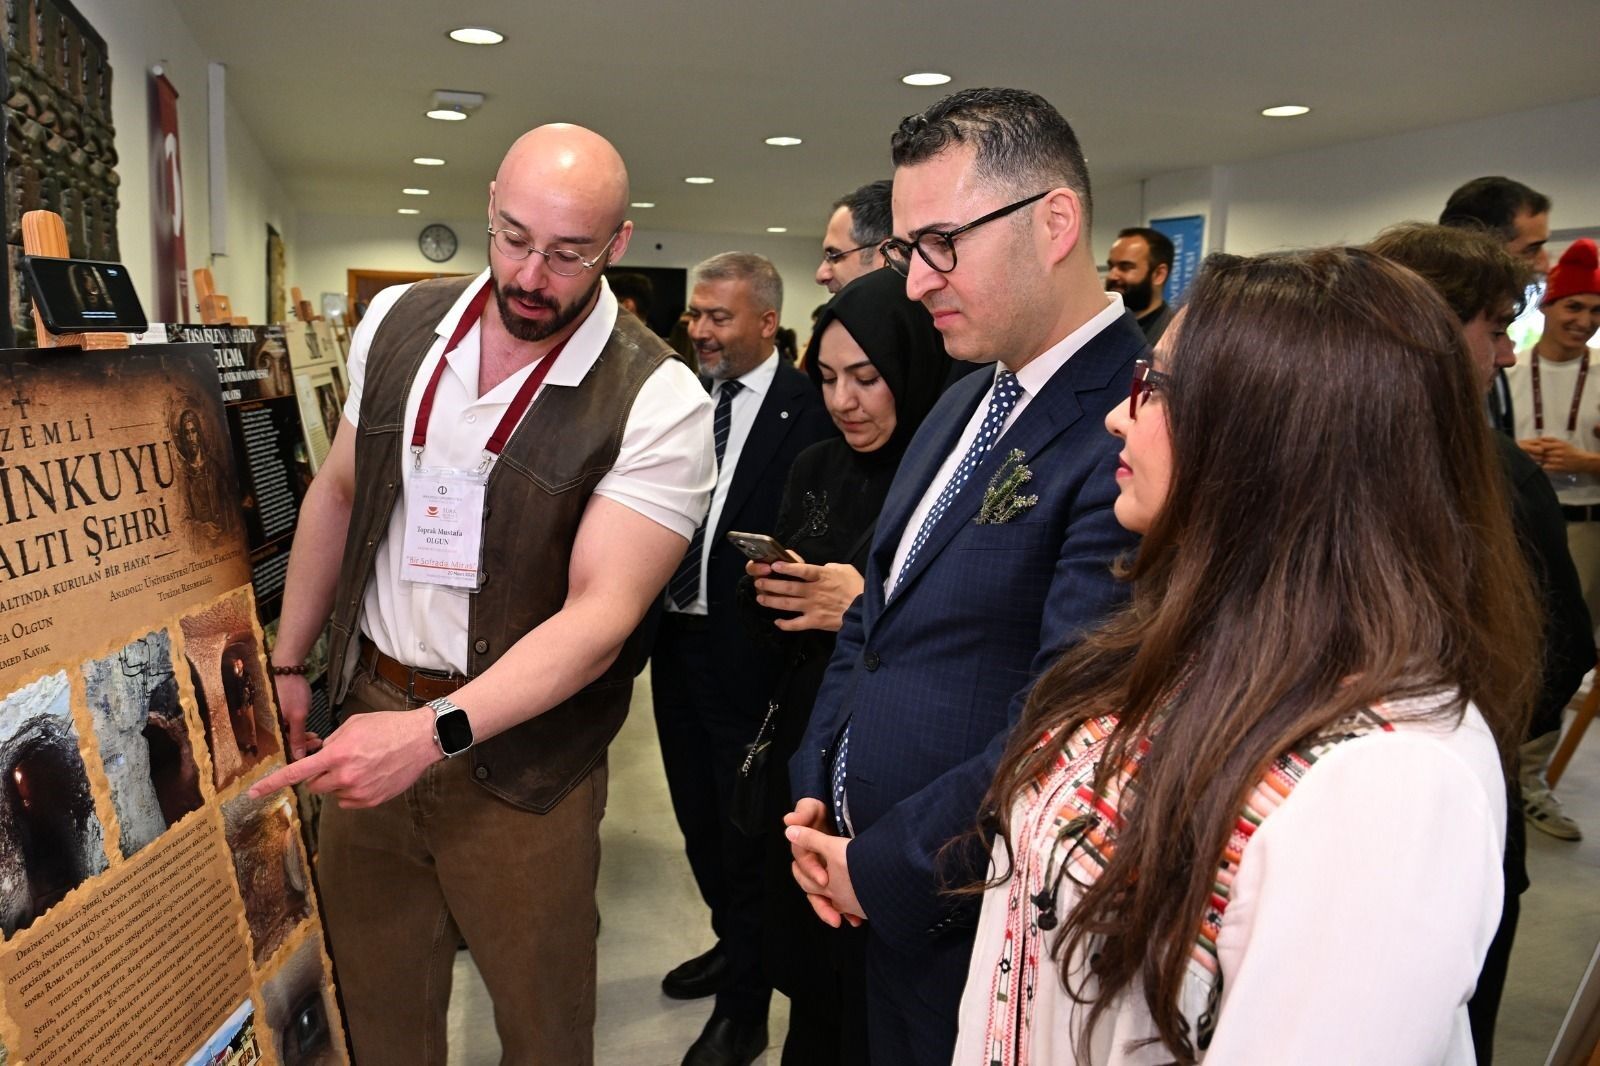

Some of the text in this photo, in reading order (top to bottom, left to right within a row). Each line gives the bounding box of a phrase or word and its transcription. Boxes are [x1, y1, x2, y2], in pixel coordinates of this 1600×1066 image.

[0, 441, 174, 526] İNKUYU
[83, 497, 172, 566] ŞEHRİ
[417, 526, 463, 537] Toprak Mustafa
[426, 537, 449, 545] OLGUN
[52, 570, 102, 595] KURULAN
[104, 563, 121, 578] BİR
[122, 554, 151, 572] HAYAT
[110, 583, 144, 602] ANADOLU
[12, 617, 54, 640] OLGUN
[22, 644, 51, 661] KAVAK
[15, 925, 54, 963] DERİNKUYU
[54, 906, 81, 934] YERALTI
[81, 891, 102, 915] ŞEHRİ,
[101, 870, 131, 900] KAPADOKYA
[8, 955, 41, 989] OYULMUŞ,
[41, 932, 69, 961] İNSANLIK
[70, 909, 100, 939] TARİHİNİN
[101, 905, 109, 916] EN
[23, 988, 44, 1010] SONRA
[44, 969, 65, 993] ROMA
[65, 965, 73, 976] VE
[104, 923, 124, 945] BİZANS
[18, 963, 51, 998] ÇEKİRDEK
[48, 969, 89, 1008] TOPLULUKLAR
[90, 942, 123, 973] TARAFINDAN
[107, 994, 117, 1009] EN
[24, 1031, 55, 1064] YALNIZCA
[75, 991, 102, 1019] ZİYARETE
[32, 1012, 56, 1040] ŞEHİR,
[56, 990, 85, 1021] YAKLAŞIK
[91, 970, 110, 990] METRE
